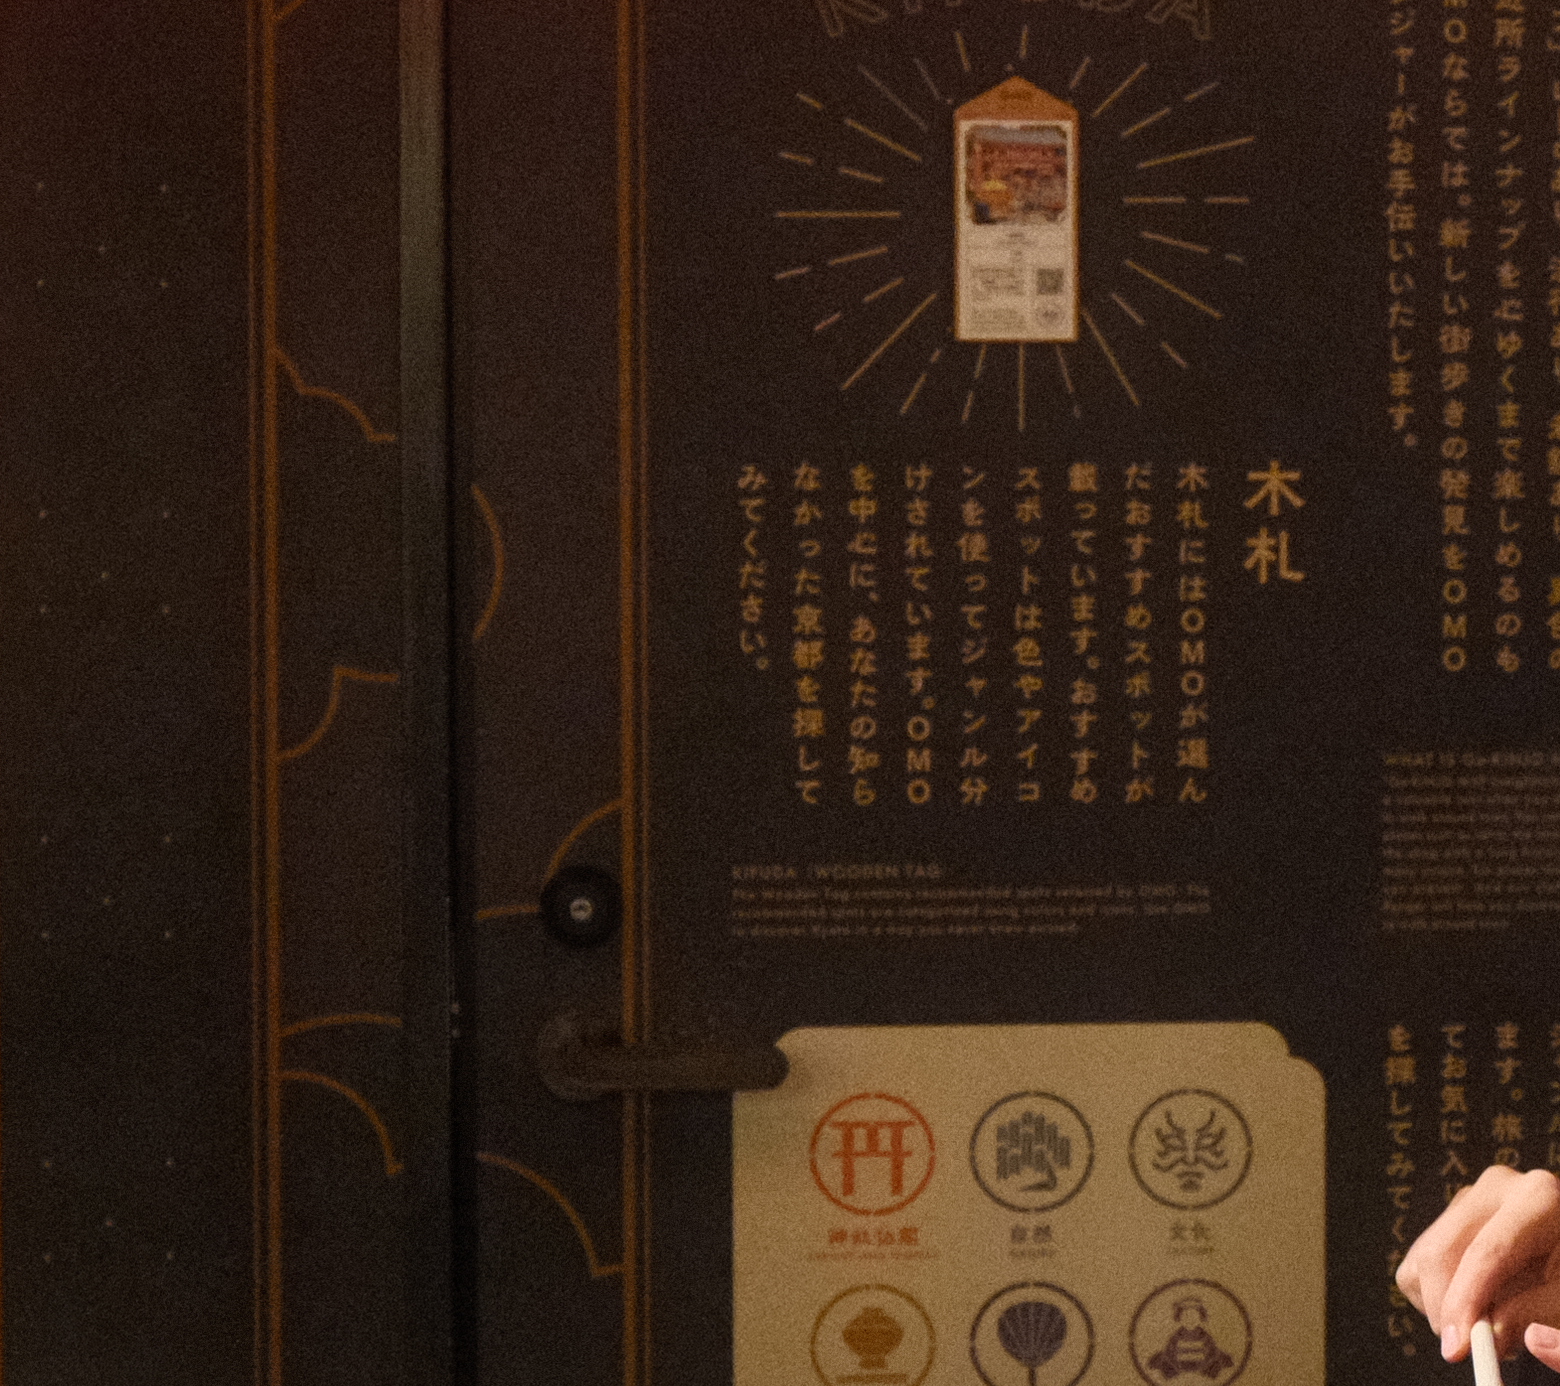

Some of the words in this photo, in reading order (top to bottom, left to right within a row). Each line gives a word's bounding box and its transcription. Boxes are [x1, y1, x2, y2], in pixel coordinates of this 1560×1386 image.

[737, 463, 770, 672] みてください。
[1243, 460, 1306, 585] 木札
